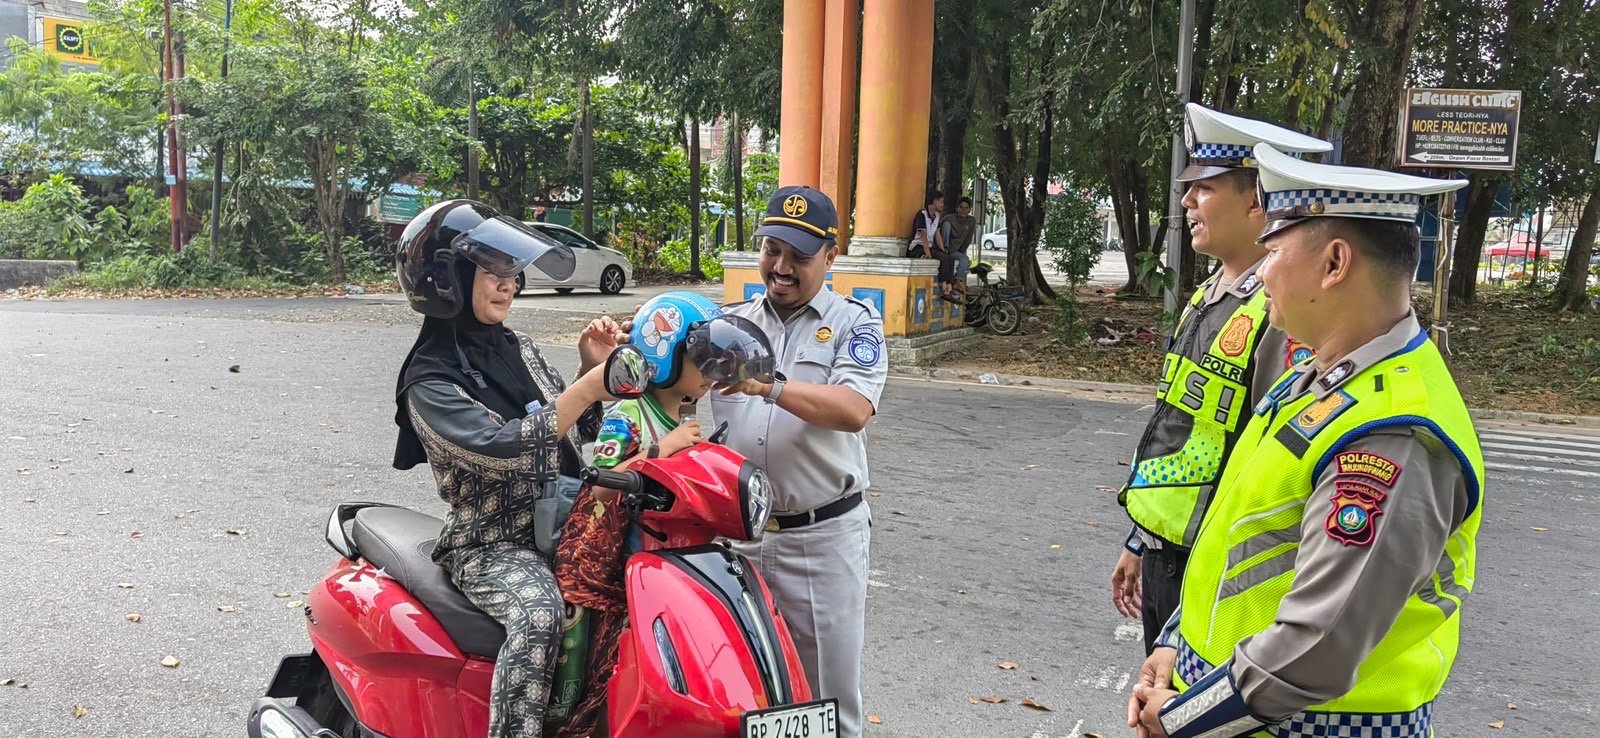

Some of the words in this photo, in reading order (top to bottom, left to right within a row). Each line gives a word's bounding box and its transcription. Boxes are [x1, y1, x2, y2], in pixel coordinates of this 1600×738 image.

[1412, 92, 1470, 106] ENGLISH
[1412, 120, 1439, 132] MORE
[1441, 121, 1508, 135] PRACTICE-NYA
[1340, 454, 1395, 474] POLRESTA
[775, 714, 809, 738] 2428
[819, 709, 834, 734] TE
